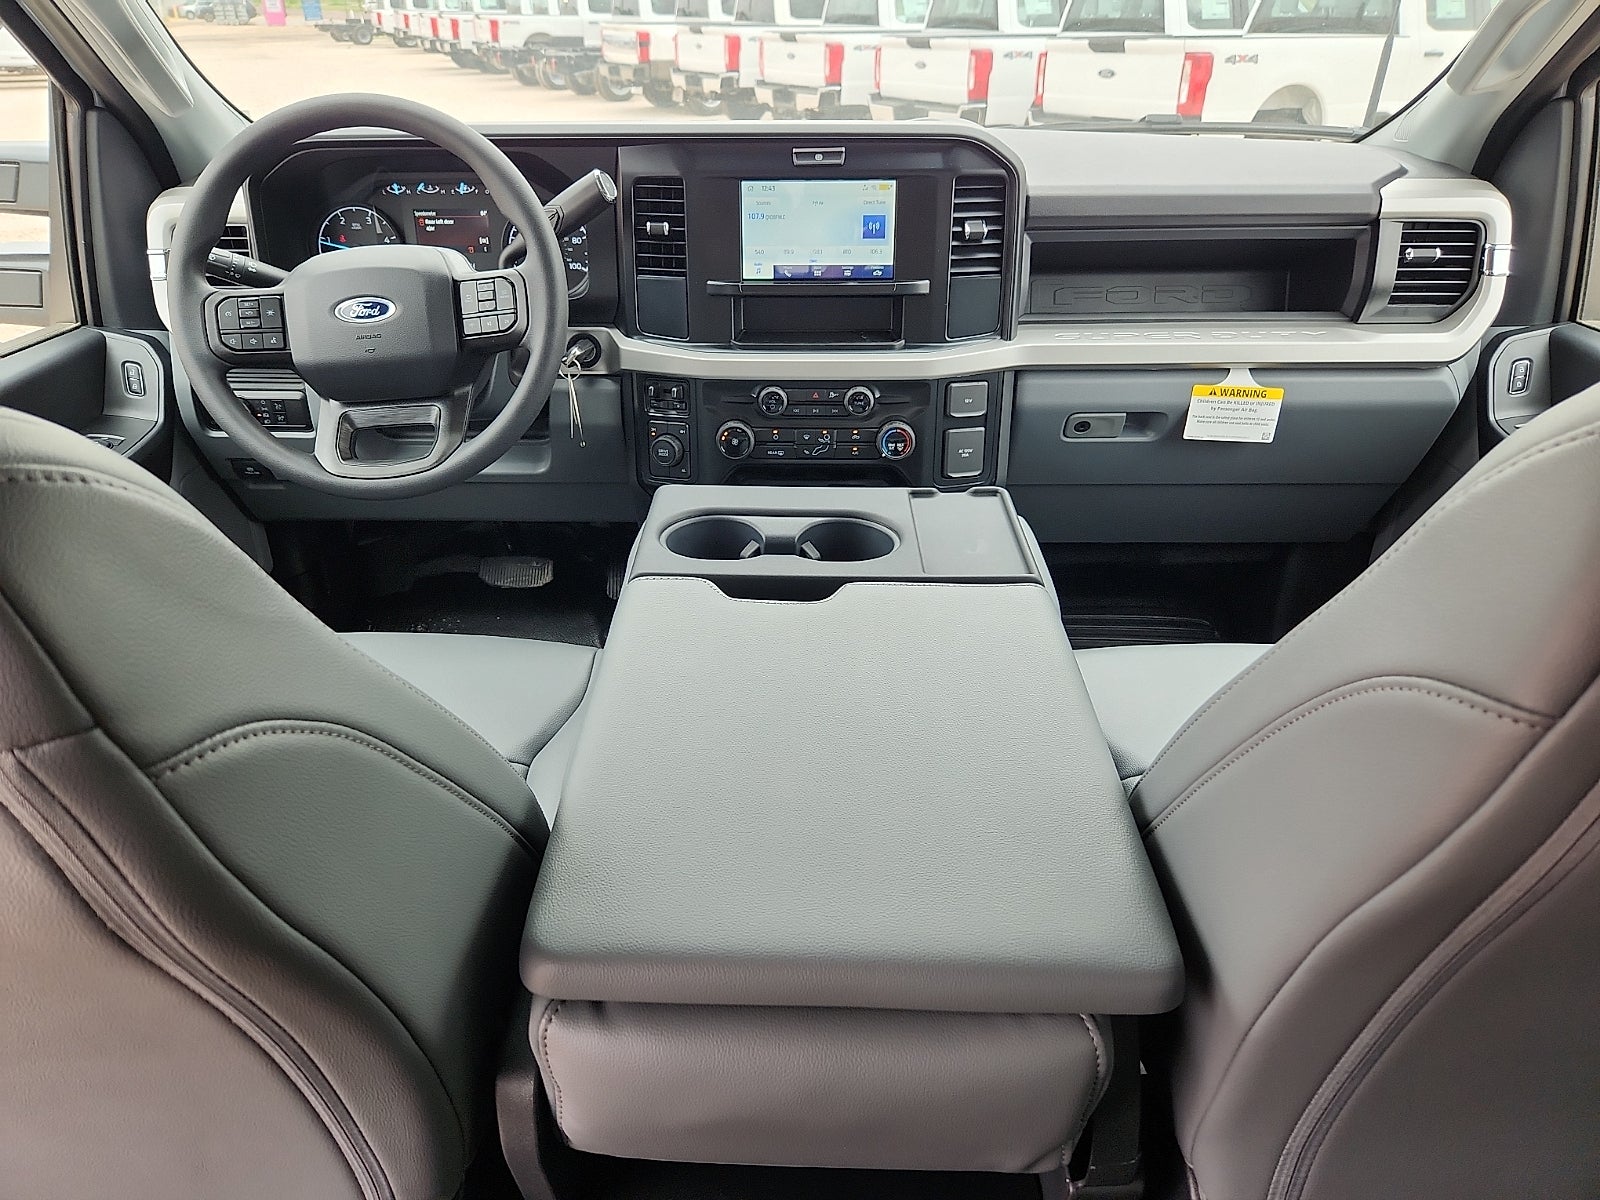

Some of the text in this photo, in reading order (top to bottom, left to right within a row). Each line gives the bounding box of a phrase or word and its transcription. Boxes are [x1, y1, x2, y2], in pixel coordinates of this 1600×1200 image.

[339, 217, 346, 225] 2
[365, 217, 372, 225] 3
[384, 236, 391, 244] 4
[1053, 285, 1251, 305] FORD
[349, 302, 381, 318] Ford
[1054, 330, 1327, 340] SUPER DUTY
[1220, 388, 1267, 399] WARNING
